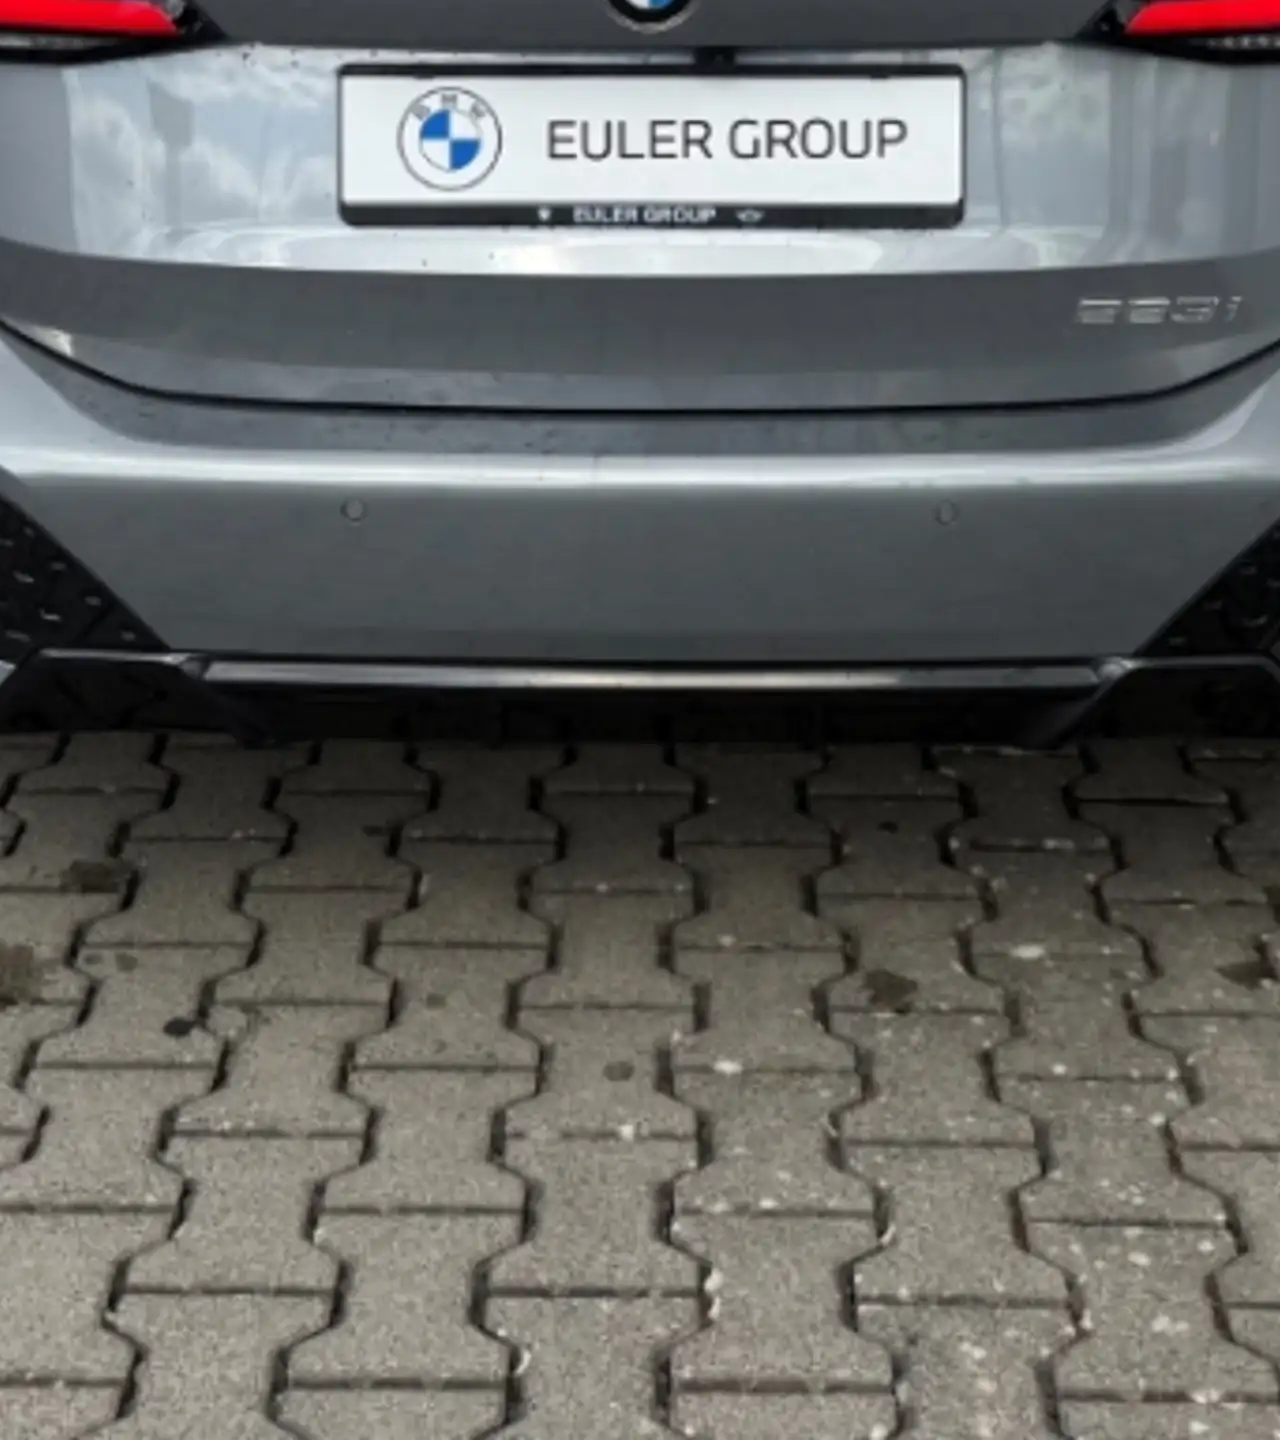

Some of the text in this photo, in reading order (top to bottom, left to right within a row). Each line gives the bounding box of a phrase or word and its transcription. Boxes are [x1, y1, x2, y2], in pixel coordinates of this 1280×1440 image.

[547, 118, 908, 160] EULER GROUP
[573, 205, 716, 224] EULER GROUP
